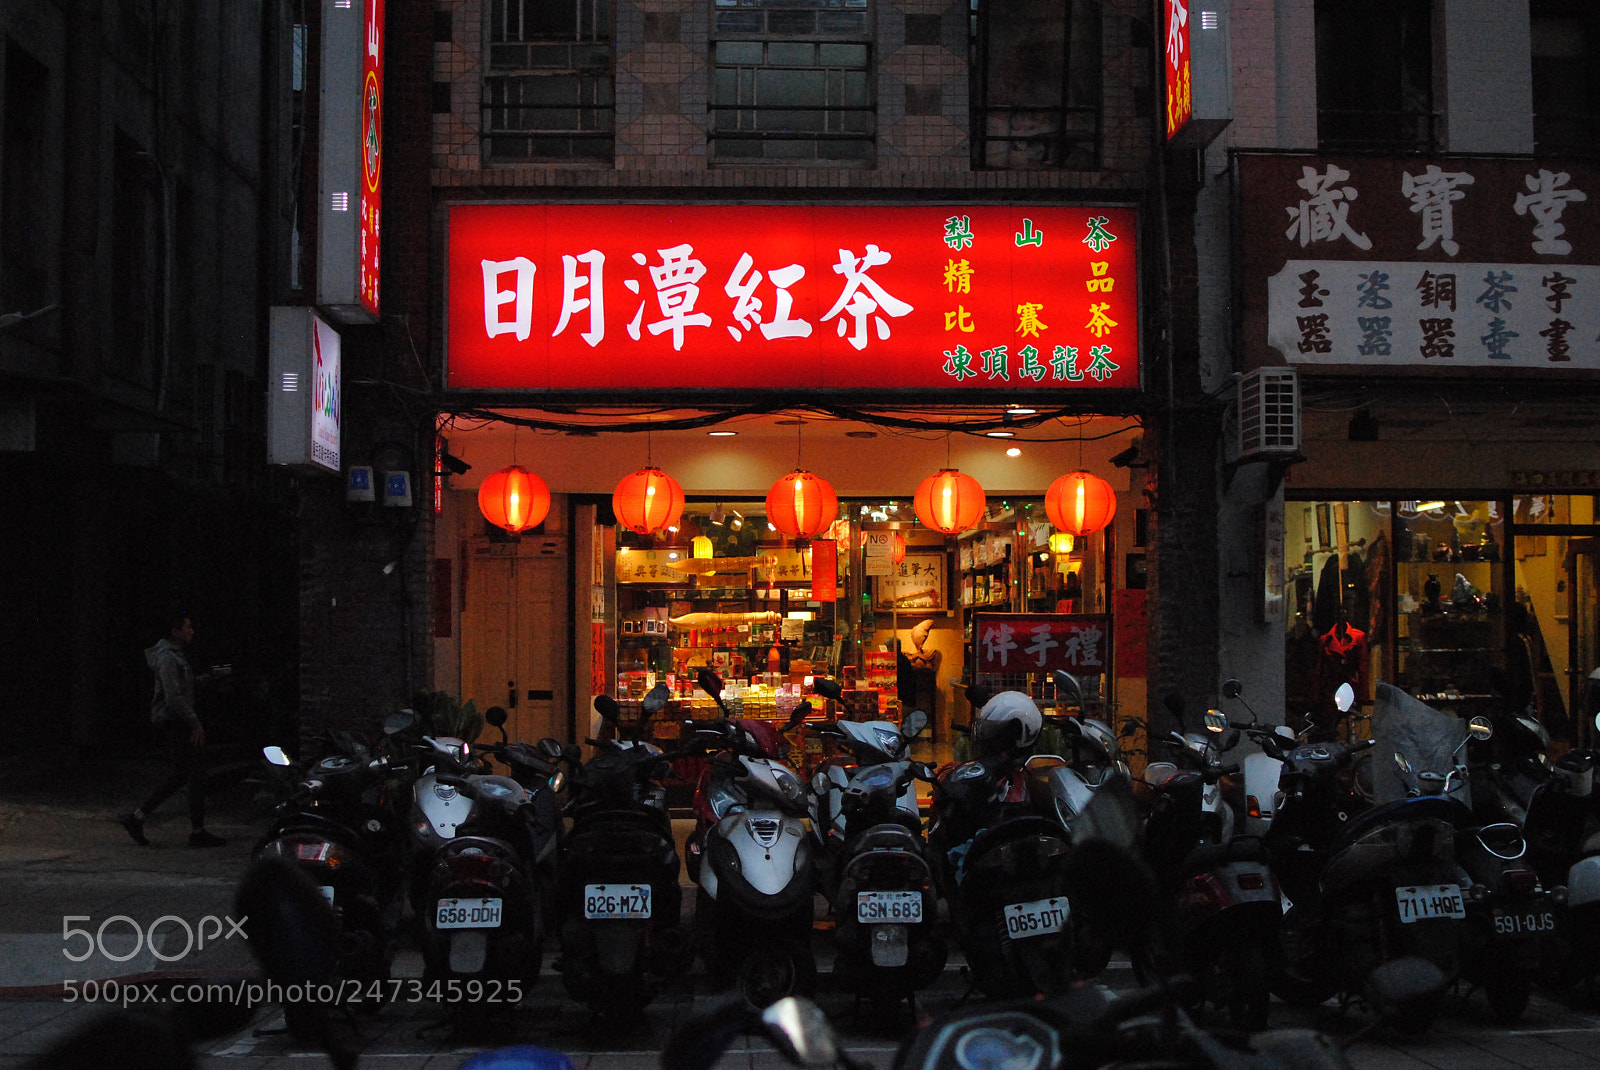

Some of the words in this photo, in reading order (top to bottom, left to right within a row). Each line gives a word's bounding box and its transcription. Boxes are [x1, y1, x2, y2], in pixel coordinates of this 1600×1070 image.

[1285, 164, 1588, 257] 藏寶堂
[943, 215, 1118, 252] 梨山茶
[481, 243, 915, 351] 日月潭紅茶
[1296, 269, 1333, 354] 玉器
[1356, 270, 1393, 356] 瓷器
[1416, 270, 1457, 359] 銅器
[944, 302, 1119, 338] 比賽茶
[942, 344, 1121, 382] 凍頂烏龍茶
[983, 623, 1103, 668] 伴手禮
[438, 907, 500, 924] 658-DDH
[587, 895, 649, 913] 826-MZX
[858, 902, 921, 918] CSN-683
